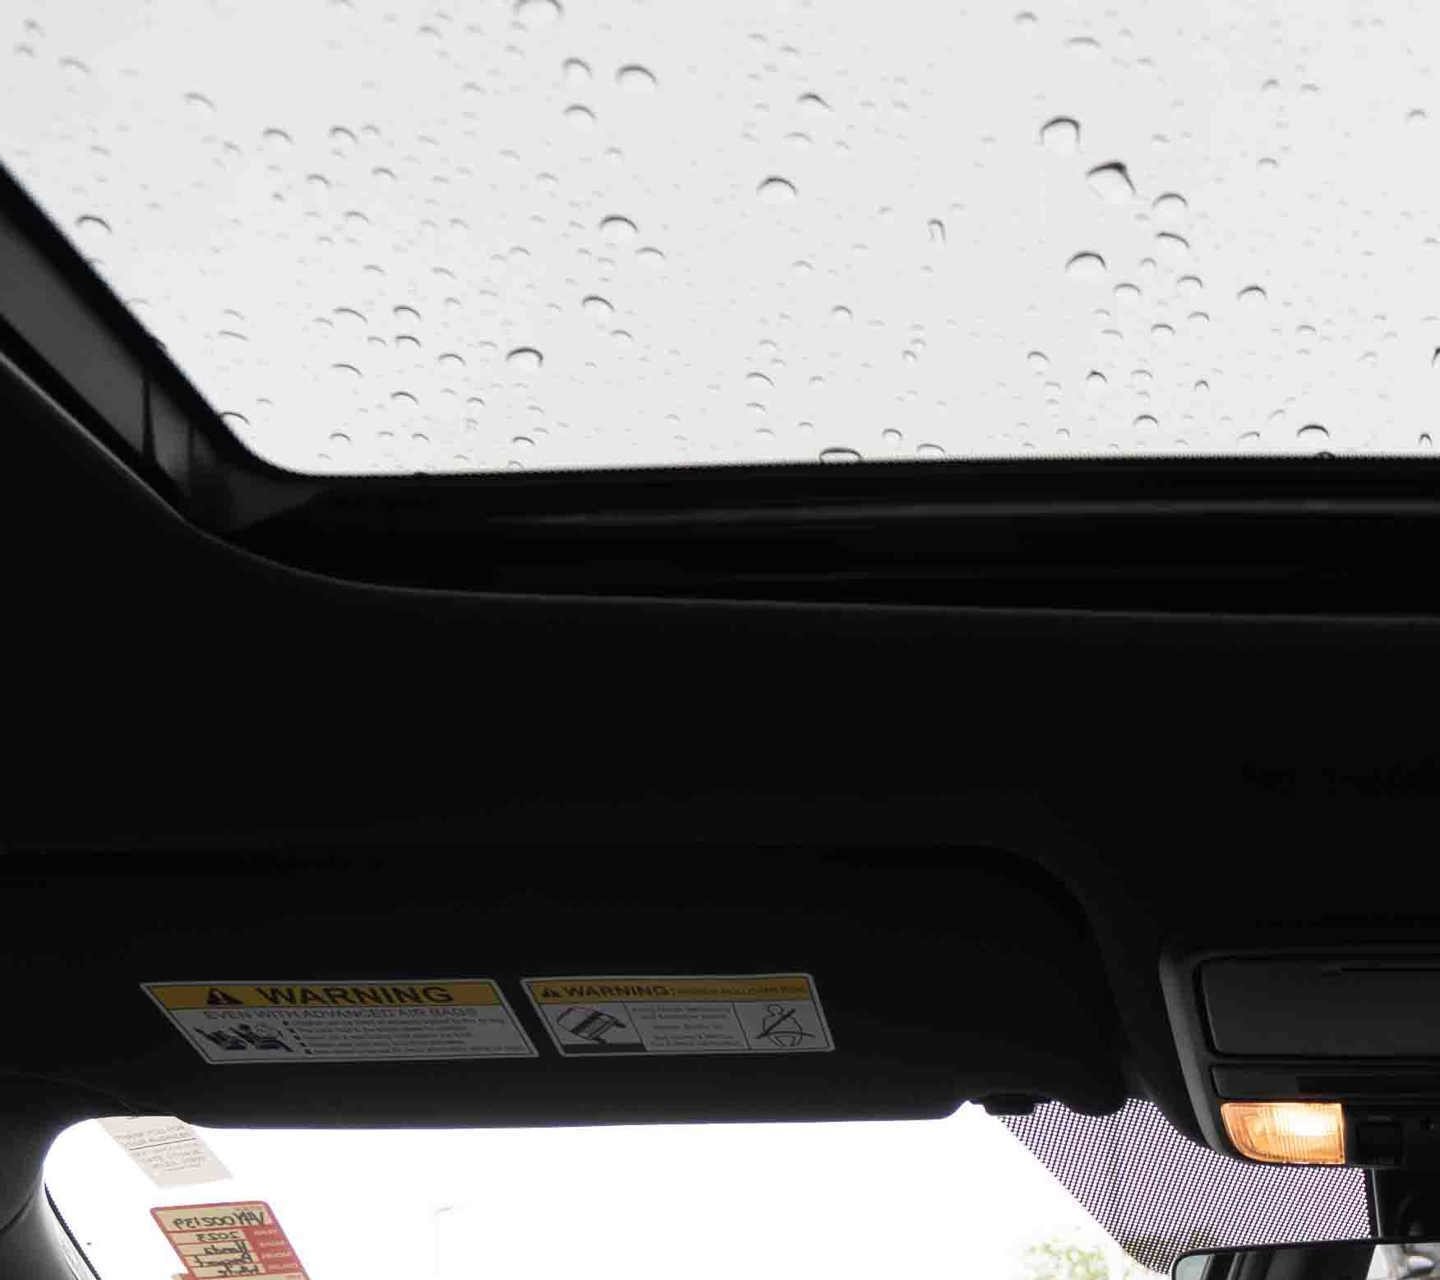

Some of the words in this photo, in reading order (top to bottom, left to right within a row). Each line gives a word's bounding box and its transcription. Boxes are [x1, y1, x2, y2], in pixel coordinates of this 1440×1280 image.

[256, 986, 455, 1005] WARNING
[205, 1009, 250, 1019] EVEN
[253, 1009, 298, 1019] WITH
[299, 1009, 393, 1019] ADVANCED
